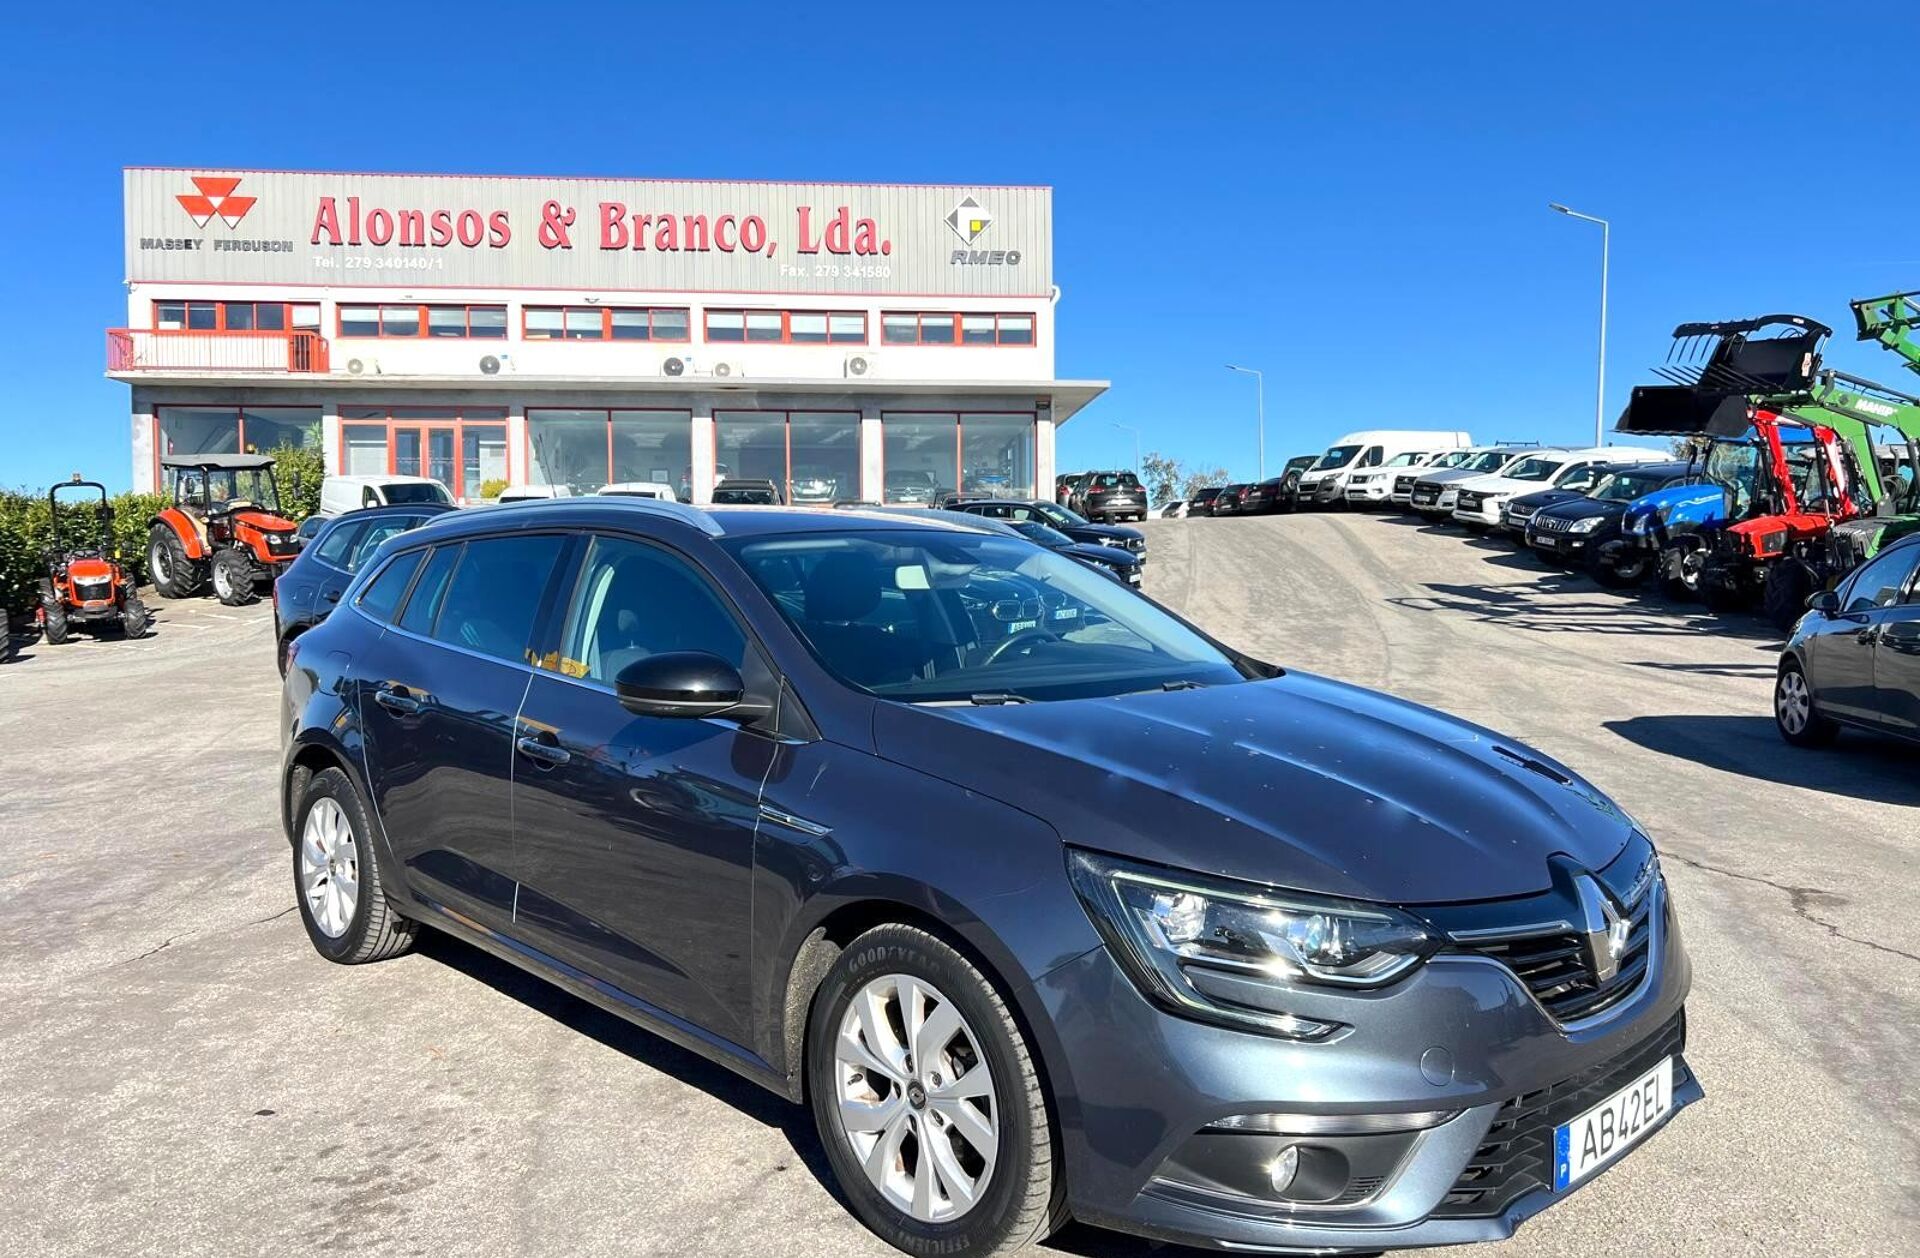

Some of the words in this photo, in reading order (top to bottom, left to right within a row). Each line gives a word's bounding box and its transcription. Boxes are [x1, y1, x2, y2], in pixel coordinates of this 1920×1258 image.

[311, 197, 511, 248] Alonsos
[538, 200, 576, 250] &
[599, 202, 777, 258] Branco,
[796, 207, 892, 256] Lda.
[140, 238, 203, 250] MASSEY
[213, 239, 294, 252] FERGUSON
[313, 256, 340, 269] Tel.
[345, 256, 372, 269] 279
[815, 264, 839, 278] 279
[1580, 1073, 1664, 1169] AB42EL
[1560, 1163, 1567, 1178] P
